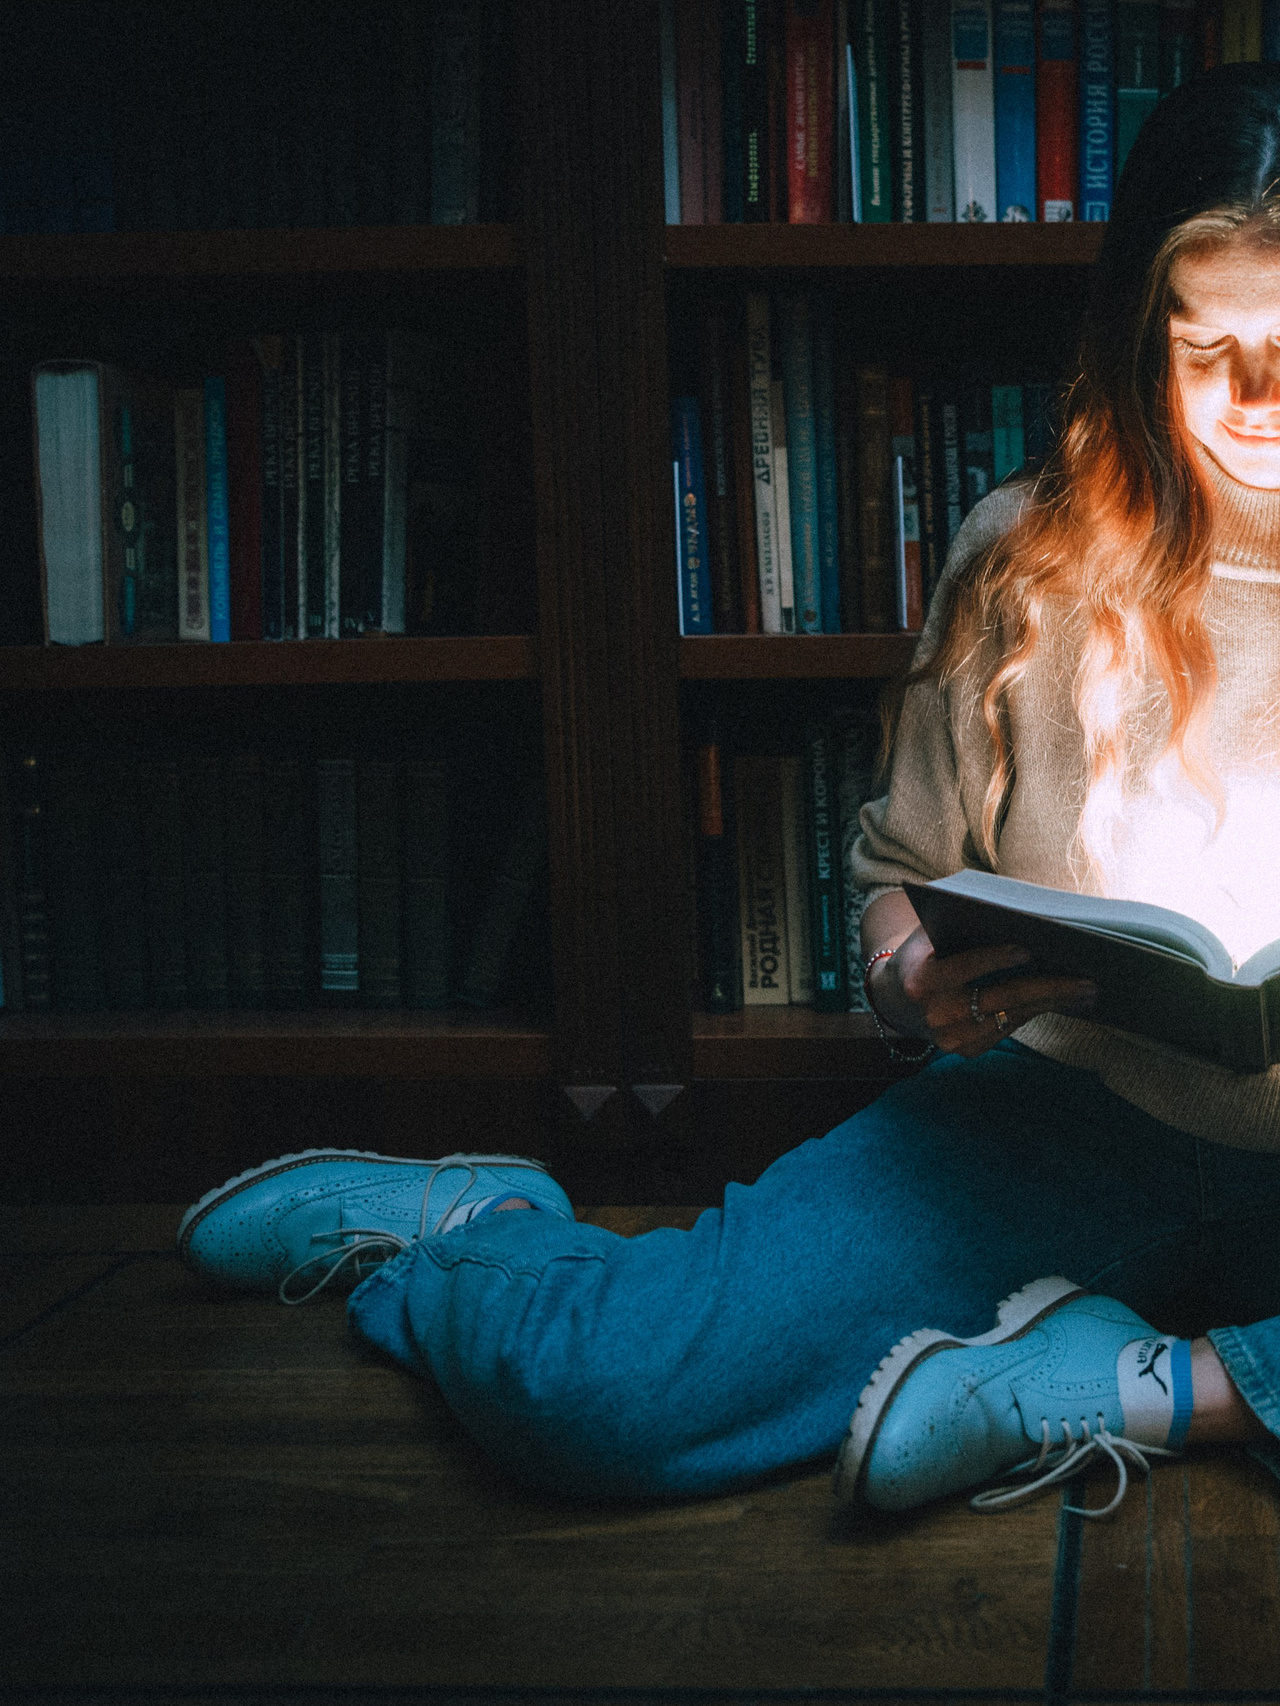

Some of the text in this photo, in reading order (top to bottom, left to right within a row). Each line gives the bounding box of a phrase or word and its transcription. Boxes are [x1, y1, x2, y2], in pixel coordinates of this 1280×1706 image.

[1085, 83, 1109, 189] ИСТОРИЯ
[751, 388, 771, 486] ДРЕВНЯЯ
[812, 738, 828, 807] КОРОНА
[814, 812, 829, 826] И
[816, 830, 831, 880] КРЕСТ
[759, 888, 780, 990] РОДНАЯ
